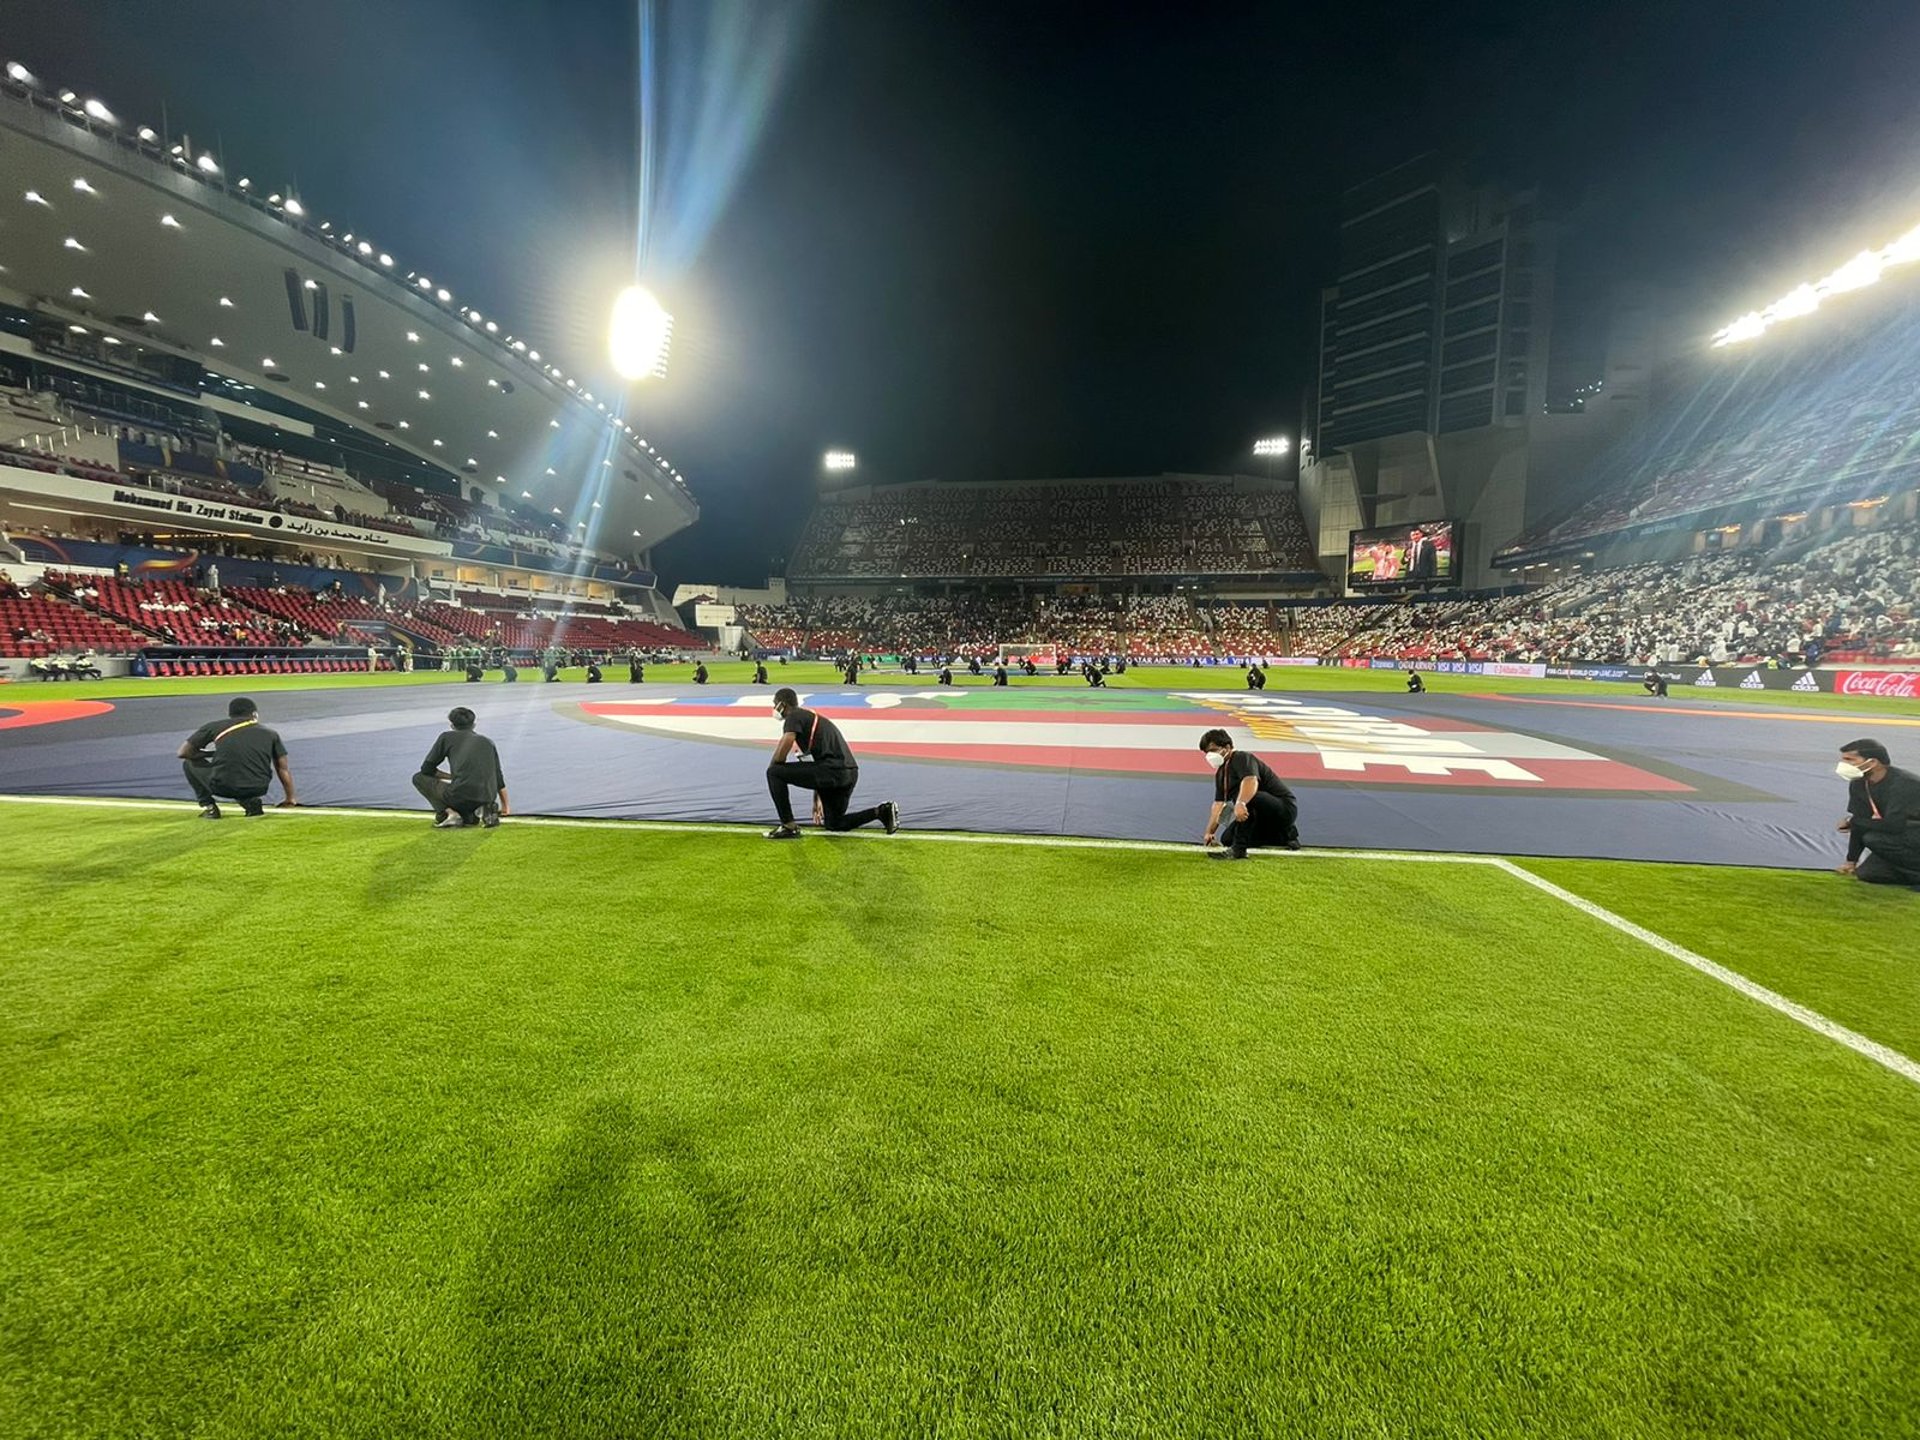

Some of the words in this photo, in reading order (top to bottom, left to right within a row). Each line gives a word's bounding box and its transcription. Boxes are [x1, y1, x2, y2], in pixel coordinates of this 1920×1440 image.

[196, 504, 226, 518] Zayed
[228, 510, 264, 525] Stadium
[1468, 663, 1482, 673] VISA
